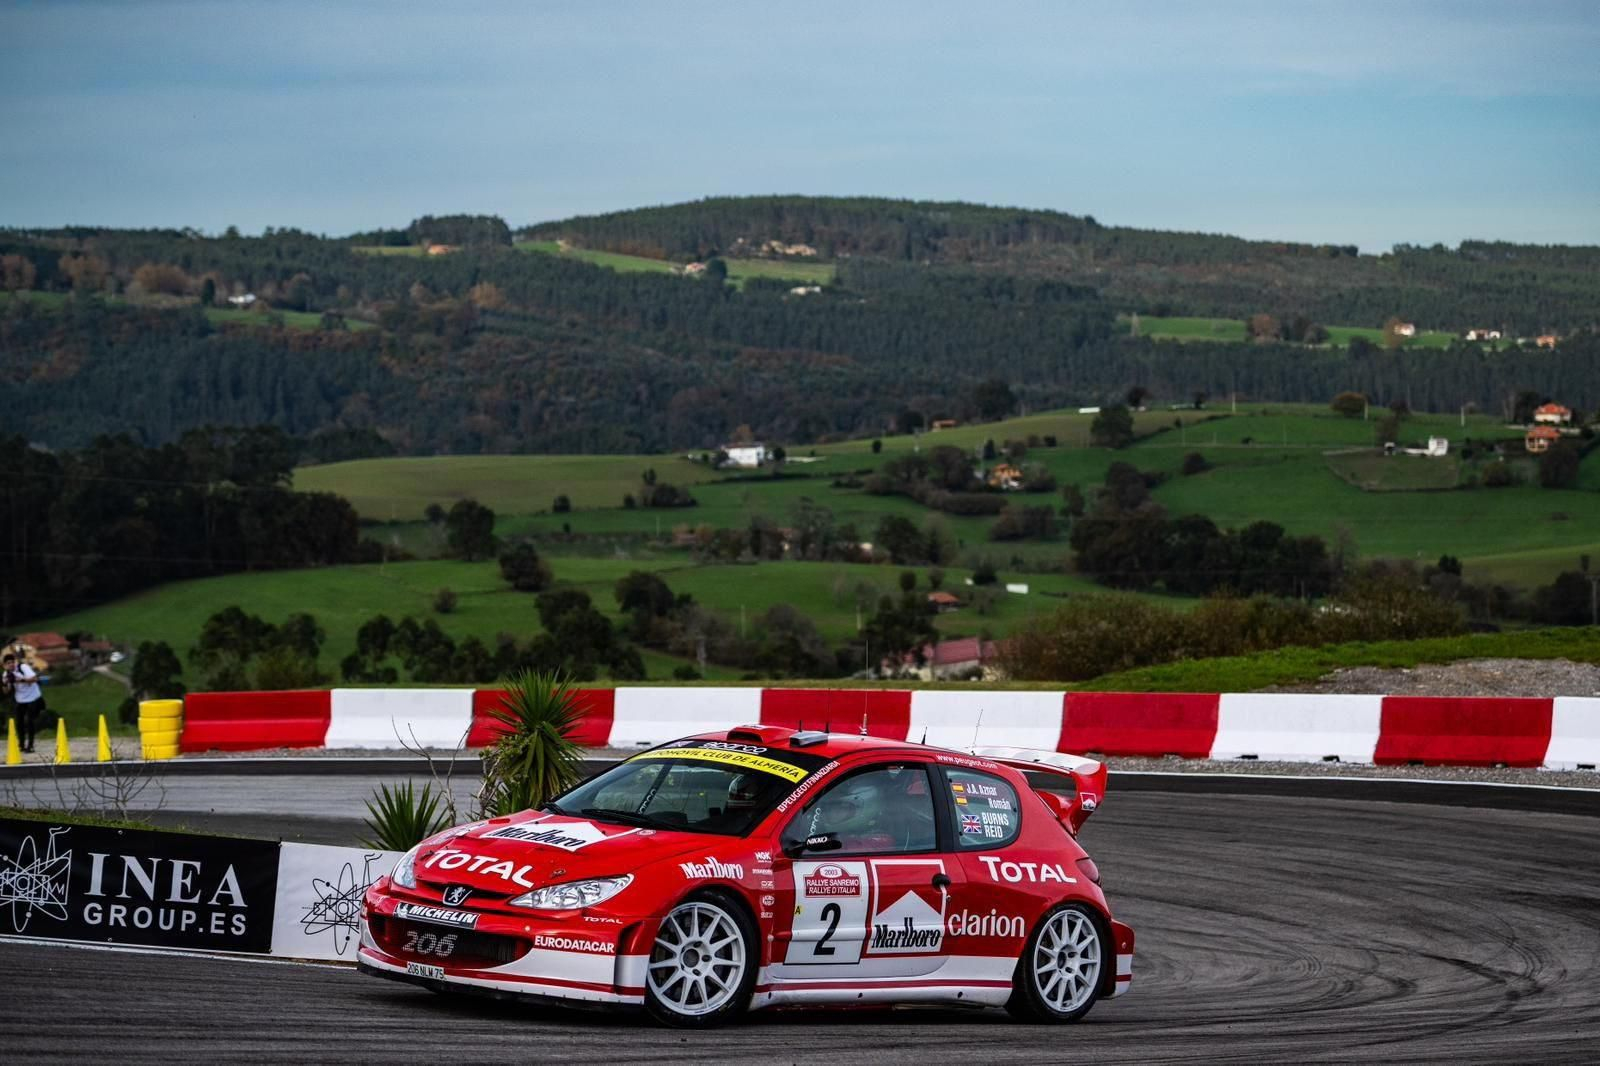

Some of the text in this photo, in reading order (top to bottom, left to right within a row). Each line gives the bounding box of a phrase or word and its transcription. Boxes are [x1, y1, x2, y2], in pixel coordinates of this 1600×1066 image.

[703, 751, 732, 759] CLUB
[733, 755, 748, 763] DE
[750, 759, 800, 778] ALMERÍA
[935, 754, 998, 769] www.peugeot.com
[981, 811, 1009, 826] BURNS
[487, 826, 587, 847] Marlboro
[984, 825, 1003, 838] REID
[425, 849, 535, 889] TOTAL
[678, 856, 744, 880] Marlboro
[978, 855, 1077, 884] TOTAL
[83, 852, 249, 908] INEA
[806, 879, 859, 887] RALLYE SANREMO
[808, 886, 831, 894] RALLYE
[83, 902, 247, 936] GROUP.ES
[408, 905, 478, 924] MICHELIN
[583, 916, 624, 924] TOTAL
[947, 908, 1025, 938] clarion
[813, 902, 842, 956] 2
[871, 916, 942, 949] Marlboro
[402, 930, 459, 957] 206
[534, 935, 615, 953] EURODATACAR
[407, 962, 420, 975] 206
[434, 967, 445, 979] 75
